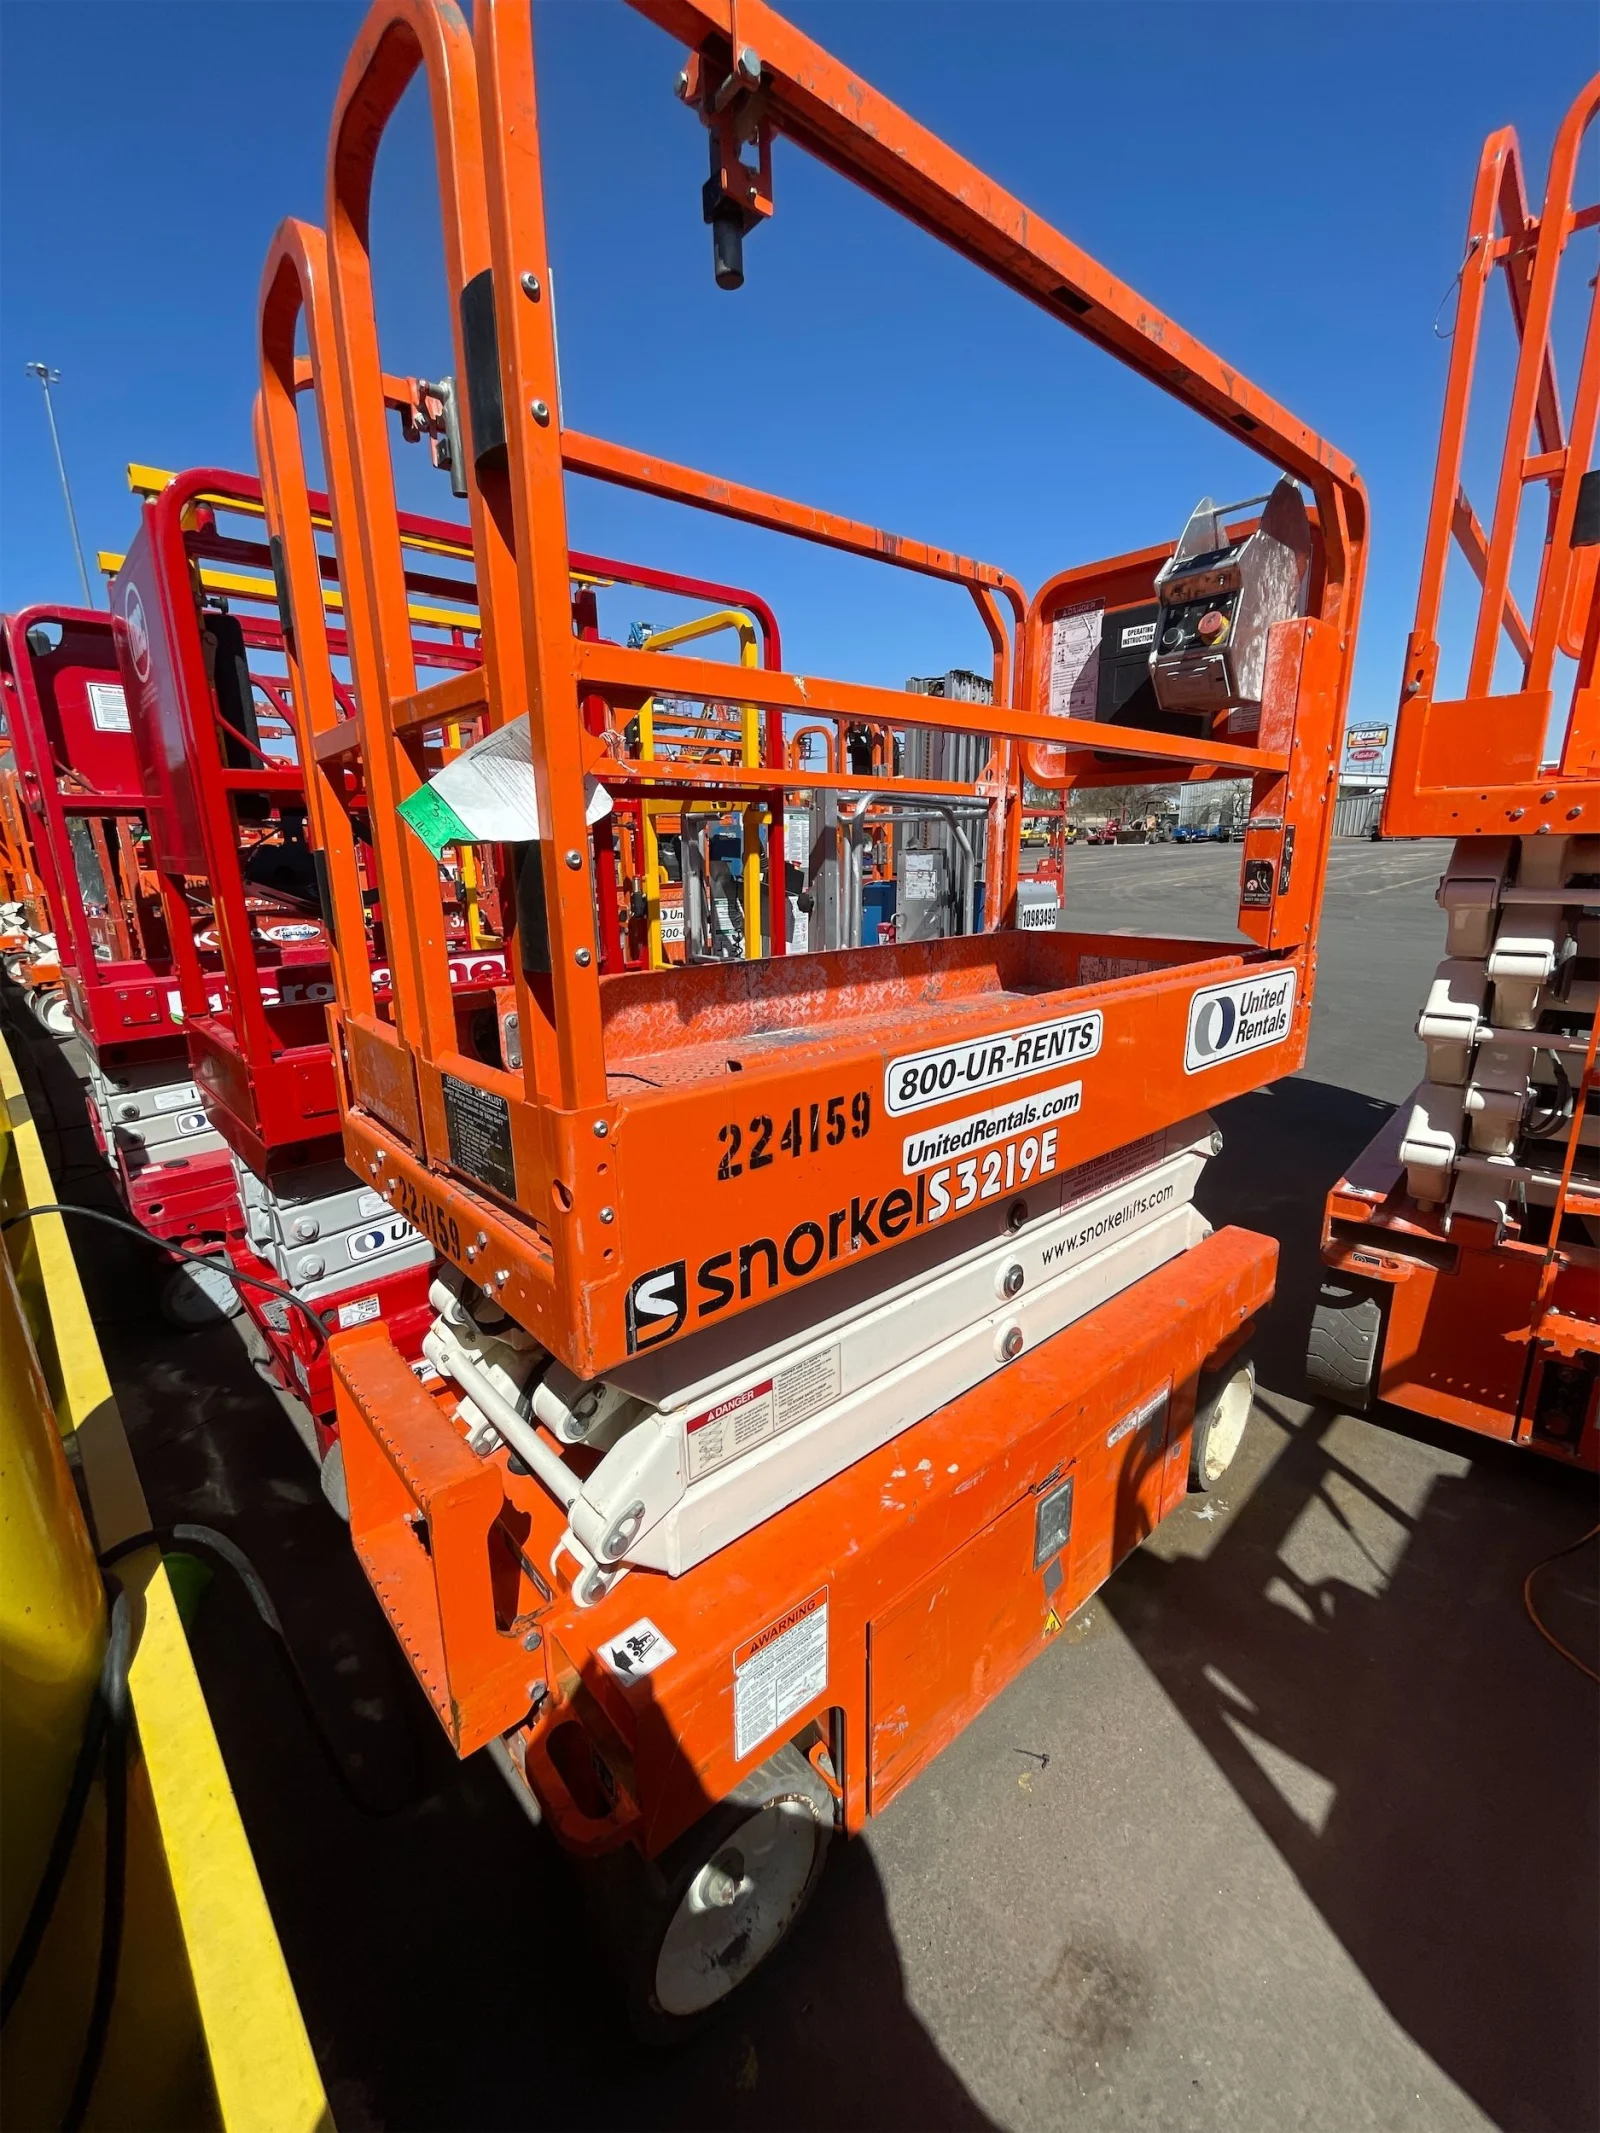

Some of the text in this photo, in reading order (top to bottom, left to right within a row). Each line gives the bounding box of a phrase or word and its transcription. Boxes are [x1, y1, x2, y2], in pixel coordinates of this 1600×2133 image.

[1068, 602, 1096, 615] DANGER
[1123, 635, 1154, 645] INSTRUCTION
[1128, 626, 1153, 636] OPERATING
[1240, 982, 1287, 1017] United
[1235, 1009, 1287, 1044] Rentals
[899, 1022, 1094, 1101] 800-UR-RENTS
[718, 1091, 871, 1181] 224159
[907, 1092, 1080, 1167] UnitedRentals.com
[697, 1173, 925, 1318] snorkel
[927, 1127, 1059, 1223] S3219E
[1042, 1184, 1174, 1266] www.snorkellifts.com
[714, 1390, 755, 1418] DANGER
[758, 1599, 817, 1647] WARNING
